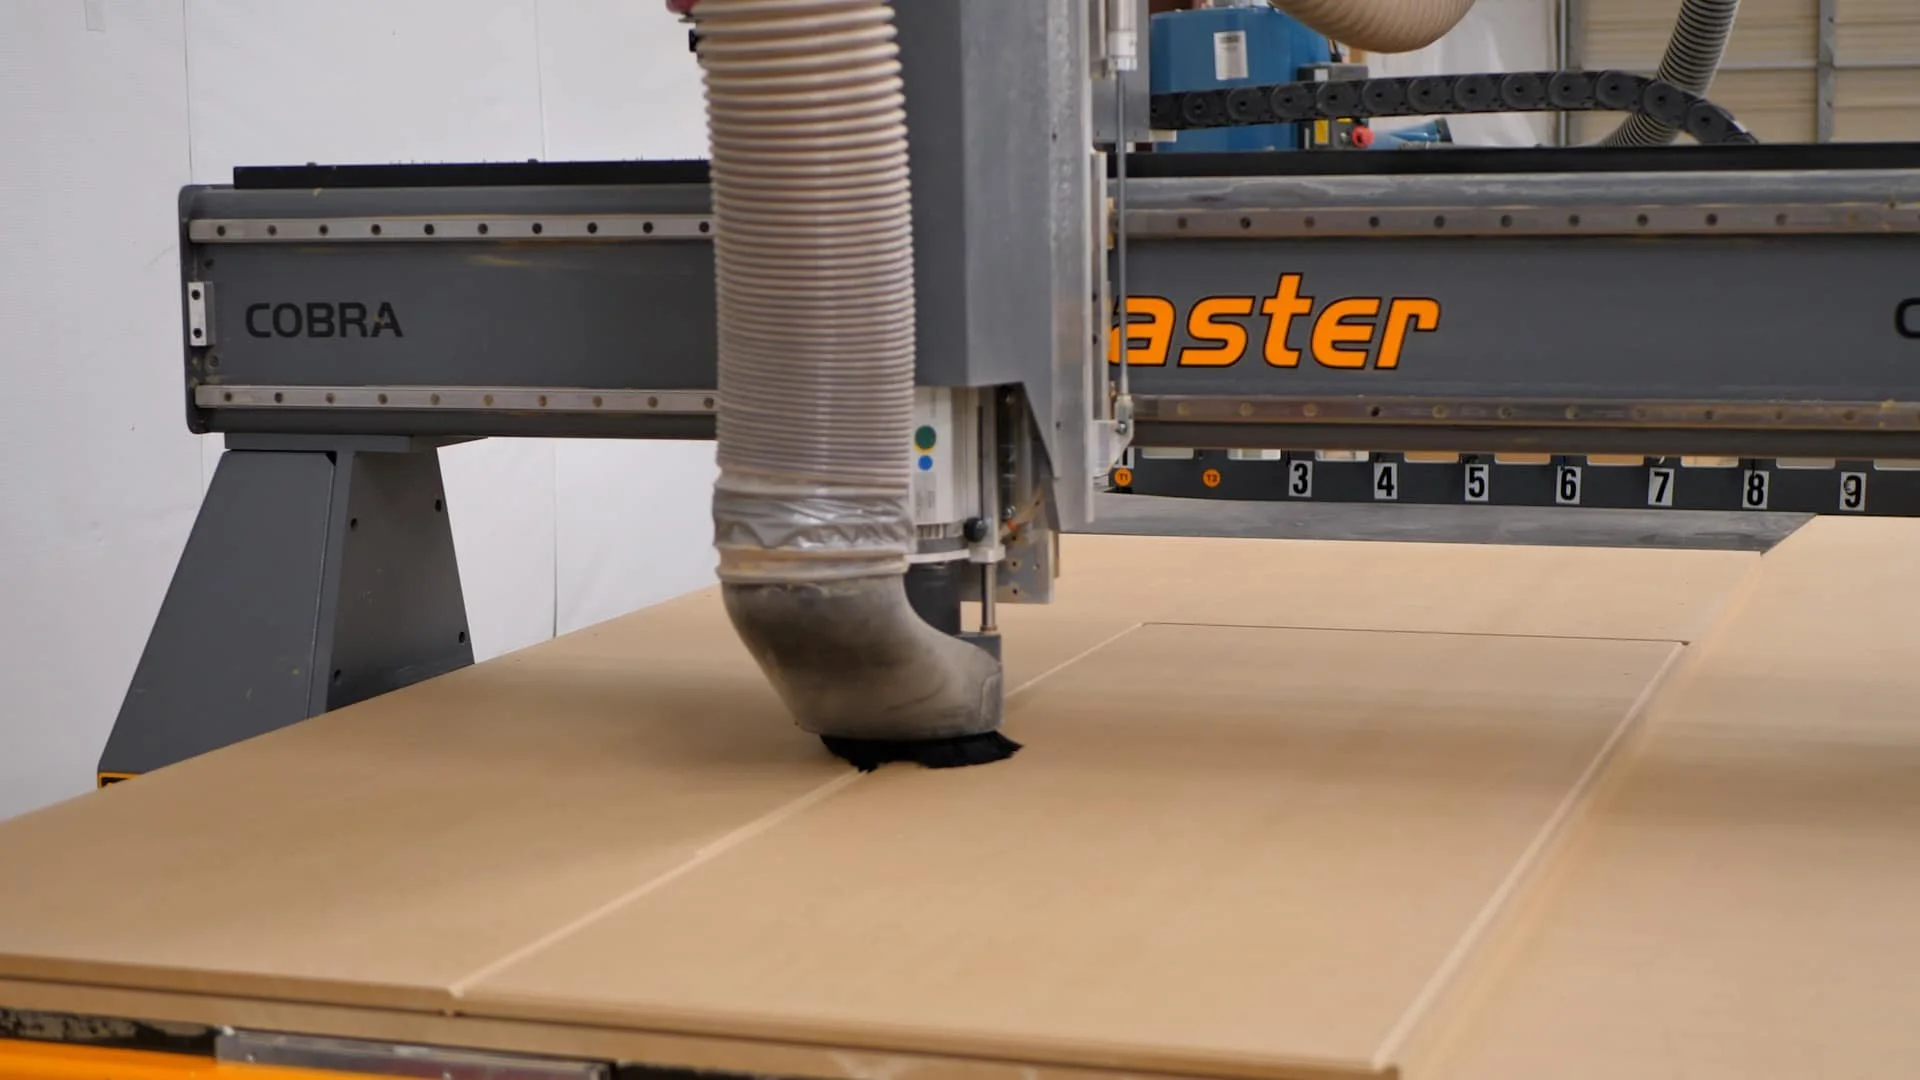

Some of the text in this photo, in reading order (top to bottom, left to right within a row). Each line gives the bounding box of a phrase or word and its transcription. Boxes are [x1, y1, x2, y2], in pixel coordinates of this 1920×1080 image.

[246, 302, 403, 338] COBRA
[1292, 463, 1309, 495] 3
[1376, 466, 1395, 497] 4
[1468, 466, 1486, 498] 5
[1560, 469, 1577, 502] 6
[1653, 472, 1670, 503] 7
[1747, 473, 1764, 506] 8
[1844, 475, 1862, 509] 9
